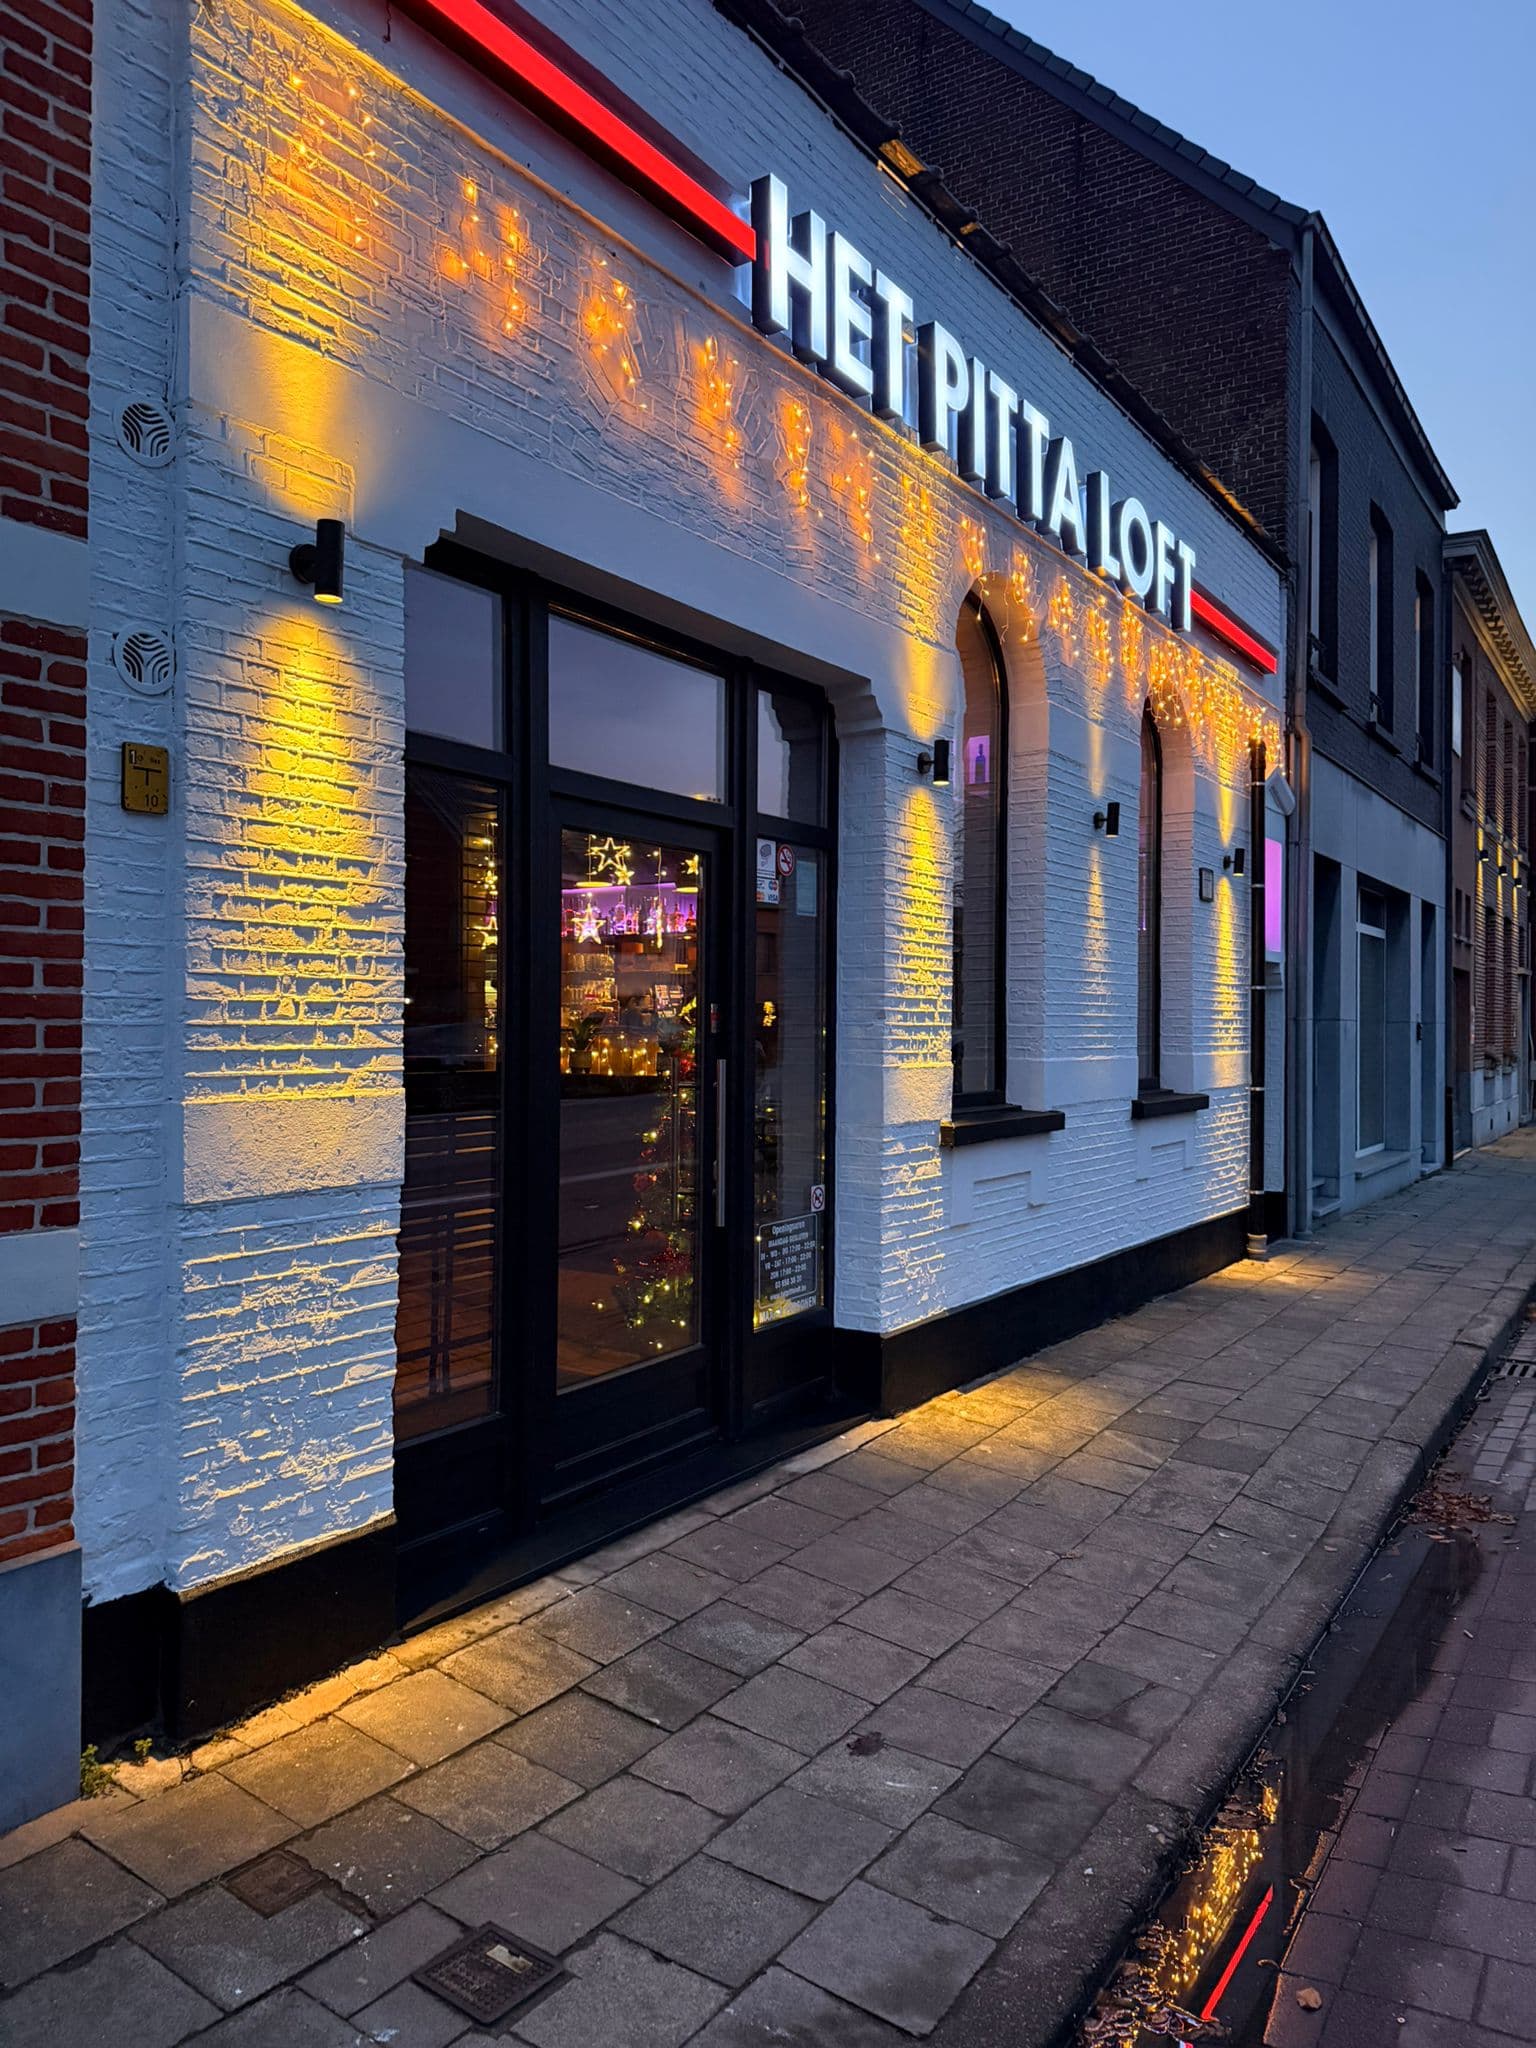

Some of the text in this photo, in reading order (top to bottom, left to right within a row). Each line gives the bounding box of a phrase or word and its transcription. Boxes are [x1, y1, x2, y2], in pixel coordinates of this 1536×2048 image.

[754, 172, 1196, 632] HET PITTA LOFT
